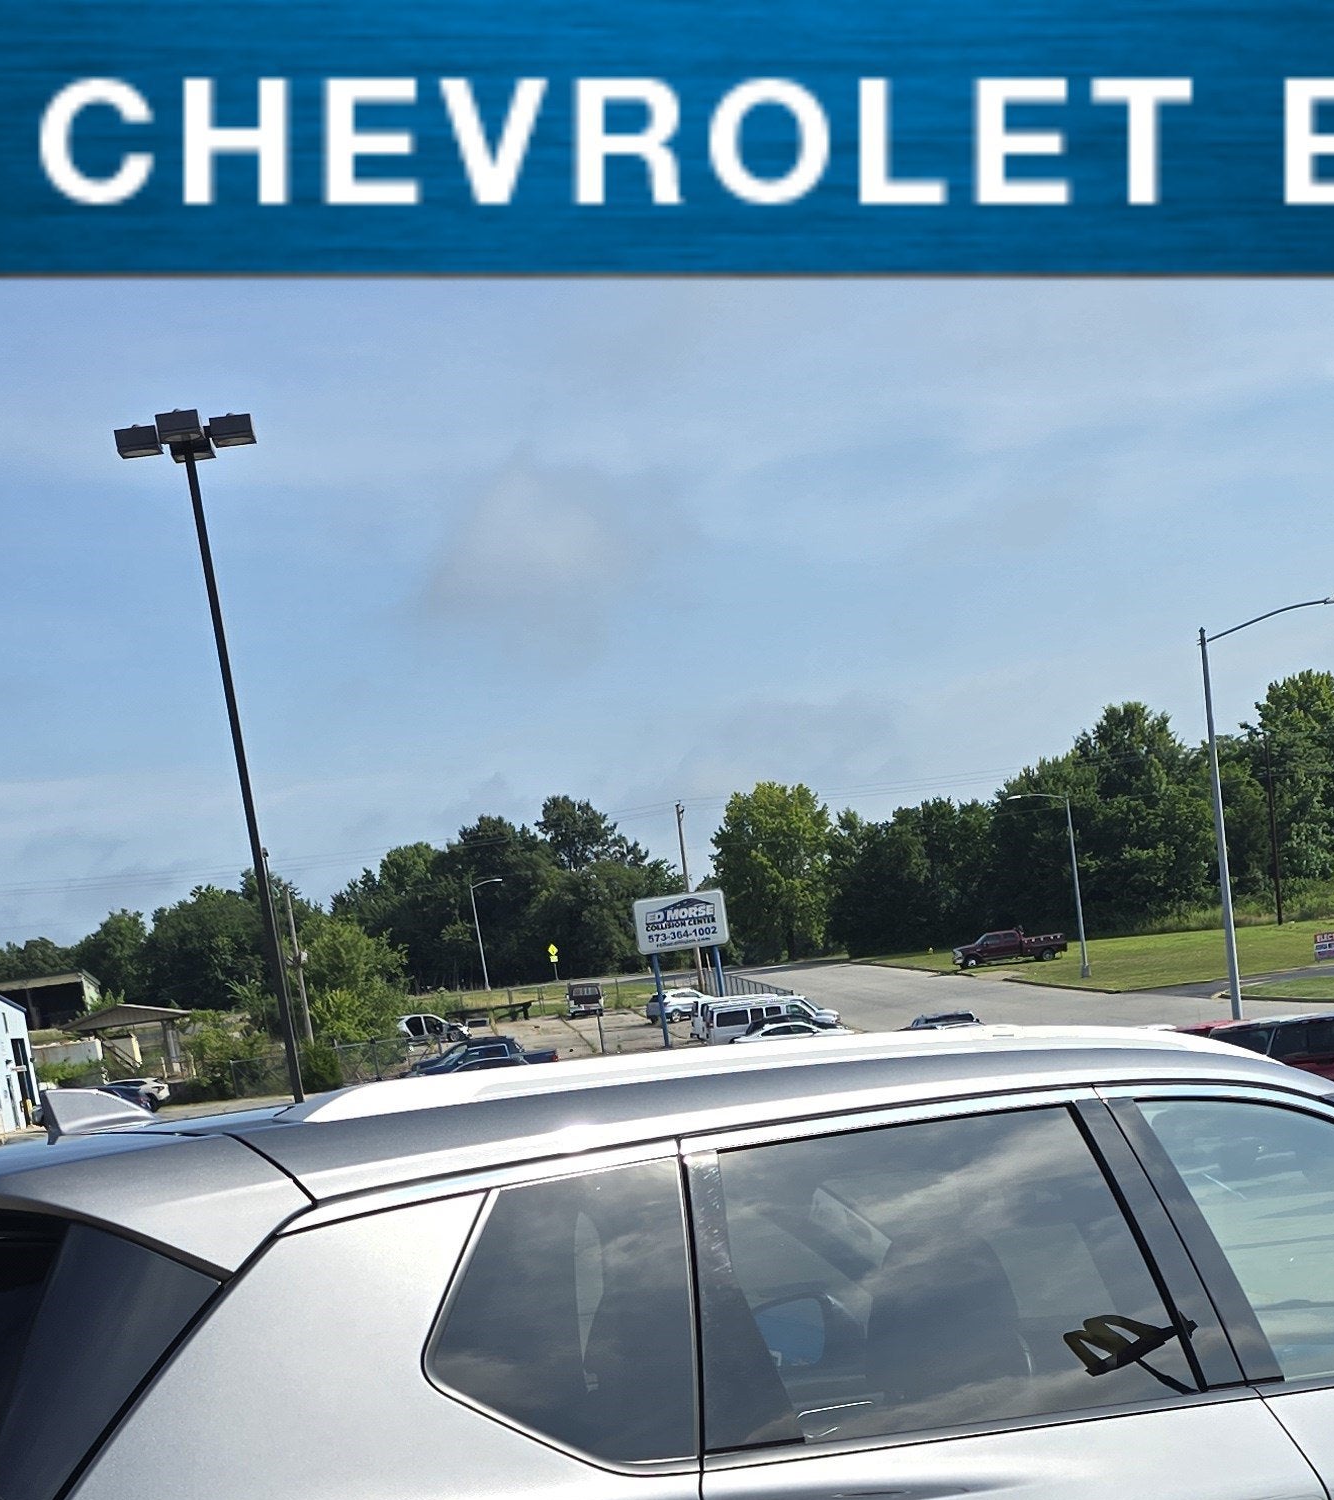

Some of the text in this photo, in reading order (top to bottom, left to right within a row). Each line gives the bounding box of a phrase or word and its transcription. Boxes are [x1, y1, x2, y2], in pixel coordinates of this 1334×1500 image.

[646, 904, 715, 923] ED MORSE
[646, 916, 716, 932] COLLISION CENTER
[648, 926, 718, 943] 573-364-1002
